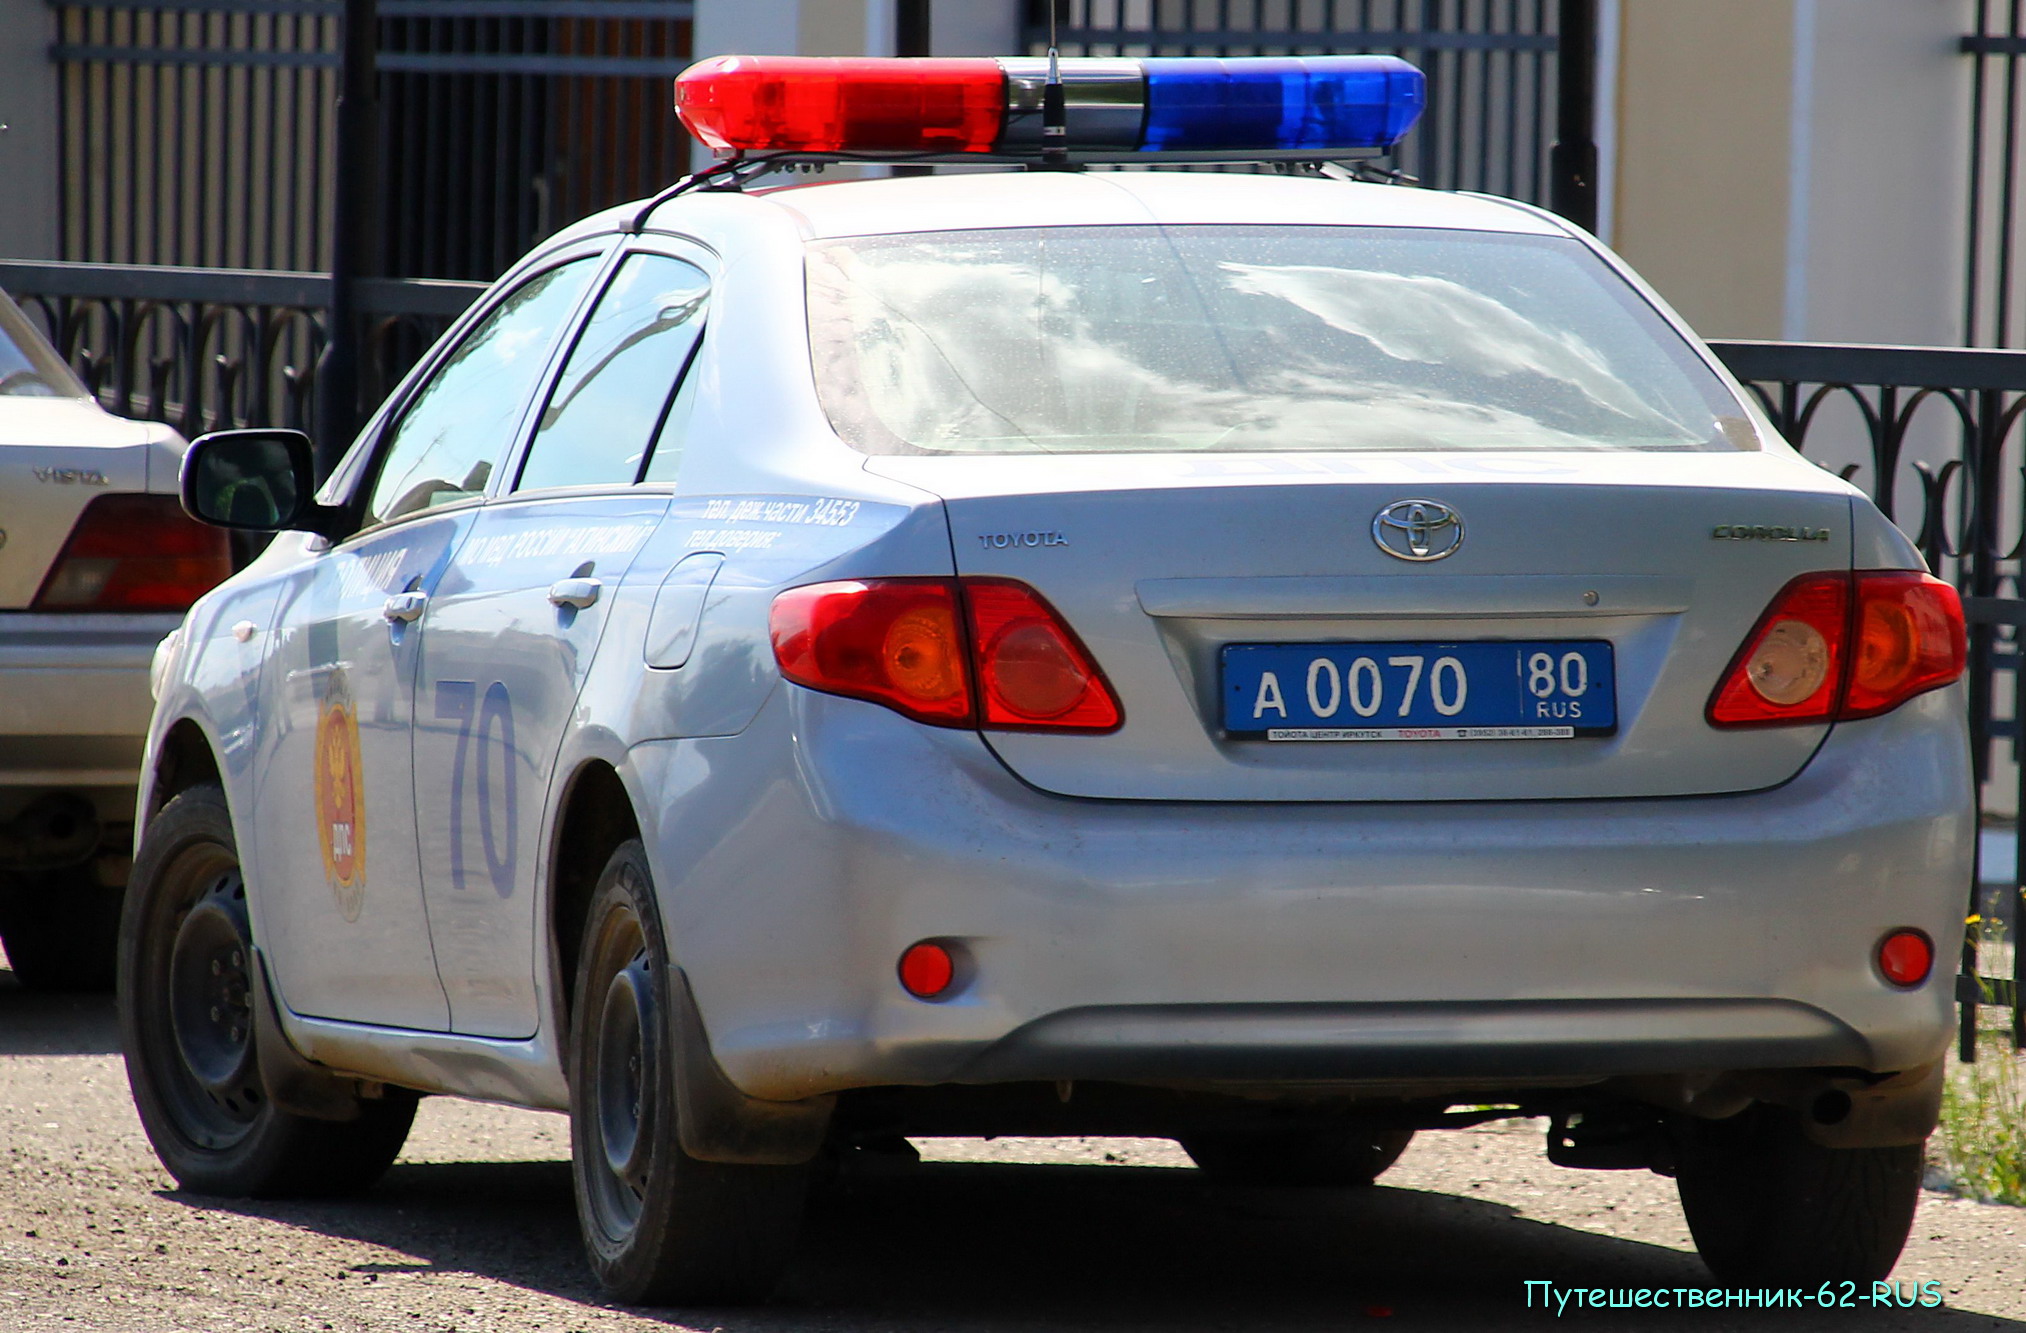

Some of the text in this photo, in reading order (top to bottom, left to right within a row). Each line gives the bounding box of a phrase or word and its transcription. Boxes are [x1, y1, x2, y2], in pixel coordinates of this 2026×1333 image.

[804, 498, 861, 527] 34553
[978, 530, 1069, 549] TOYOTA
[1712, 524, 1831, 542] COROLLA
[1306, 655, 1468, 719] 0070
[1528, 651, 1588, 698] 80
[1536, 701, 1583, 719] RUS
[1273, 730, 1309, 739] ТОЙОТА
[1309, 730, 1341, 739] ЦЕНТР
[1342, 729, 1383, 739] ИРКУТСК
[1398, 729, 1442, 738] TOYOTA
[435, 680, 518, 900] 70
[332, 823, 352, 862] ДПС
